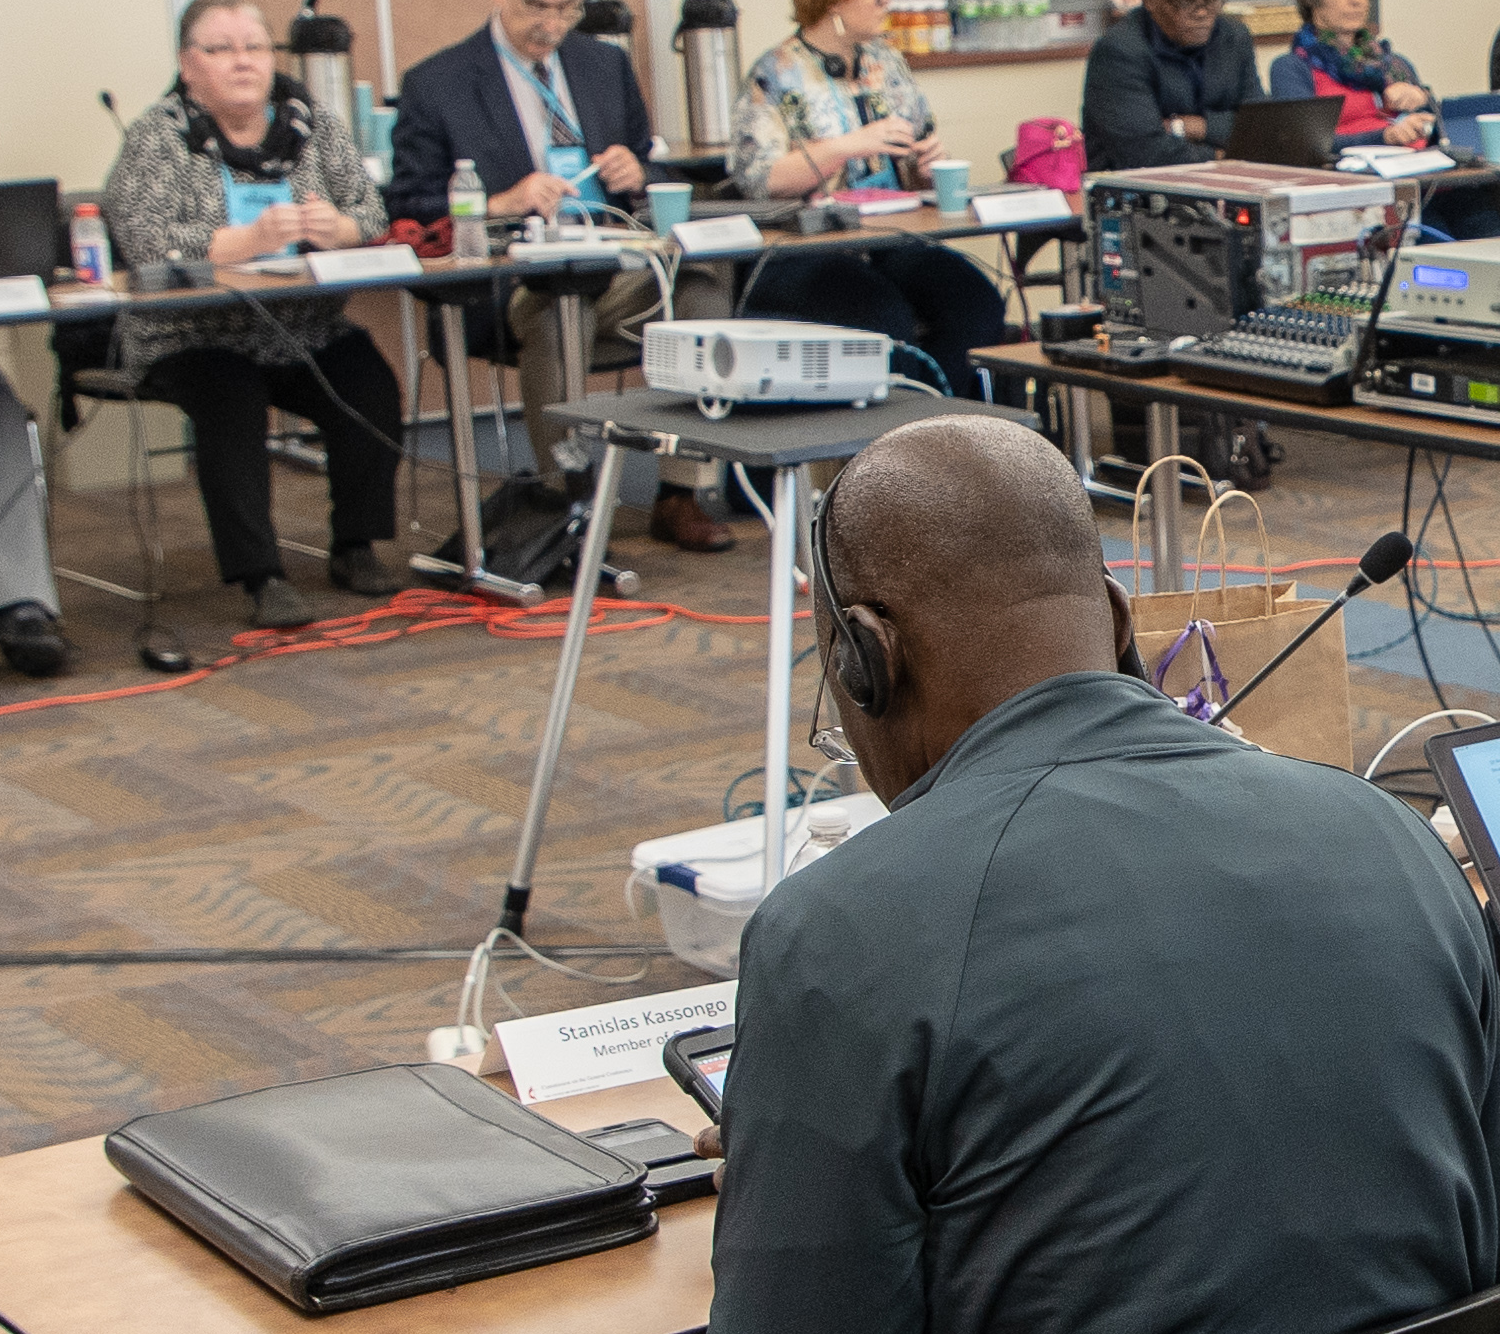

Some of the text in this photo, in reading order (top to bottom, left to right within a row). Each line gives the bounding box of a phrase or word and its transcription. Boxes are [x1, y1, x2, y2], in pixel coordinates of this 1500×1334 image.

[558, 999, 728, 1043] Stanislas Kassongo
[593, 1037, 652, 1058] Member
[656, 1031, 669, 1046] of
